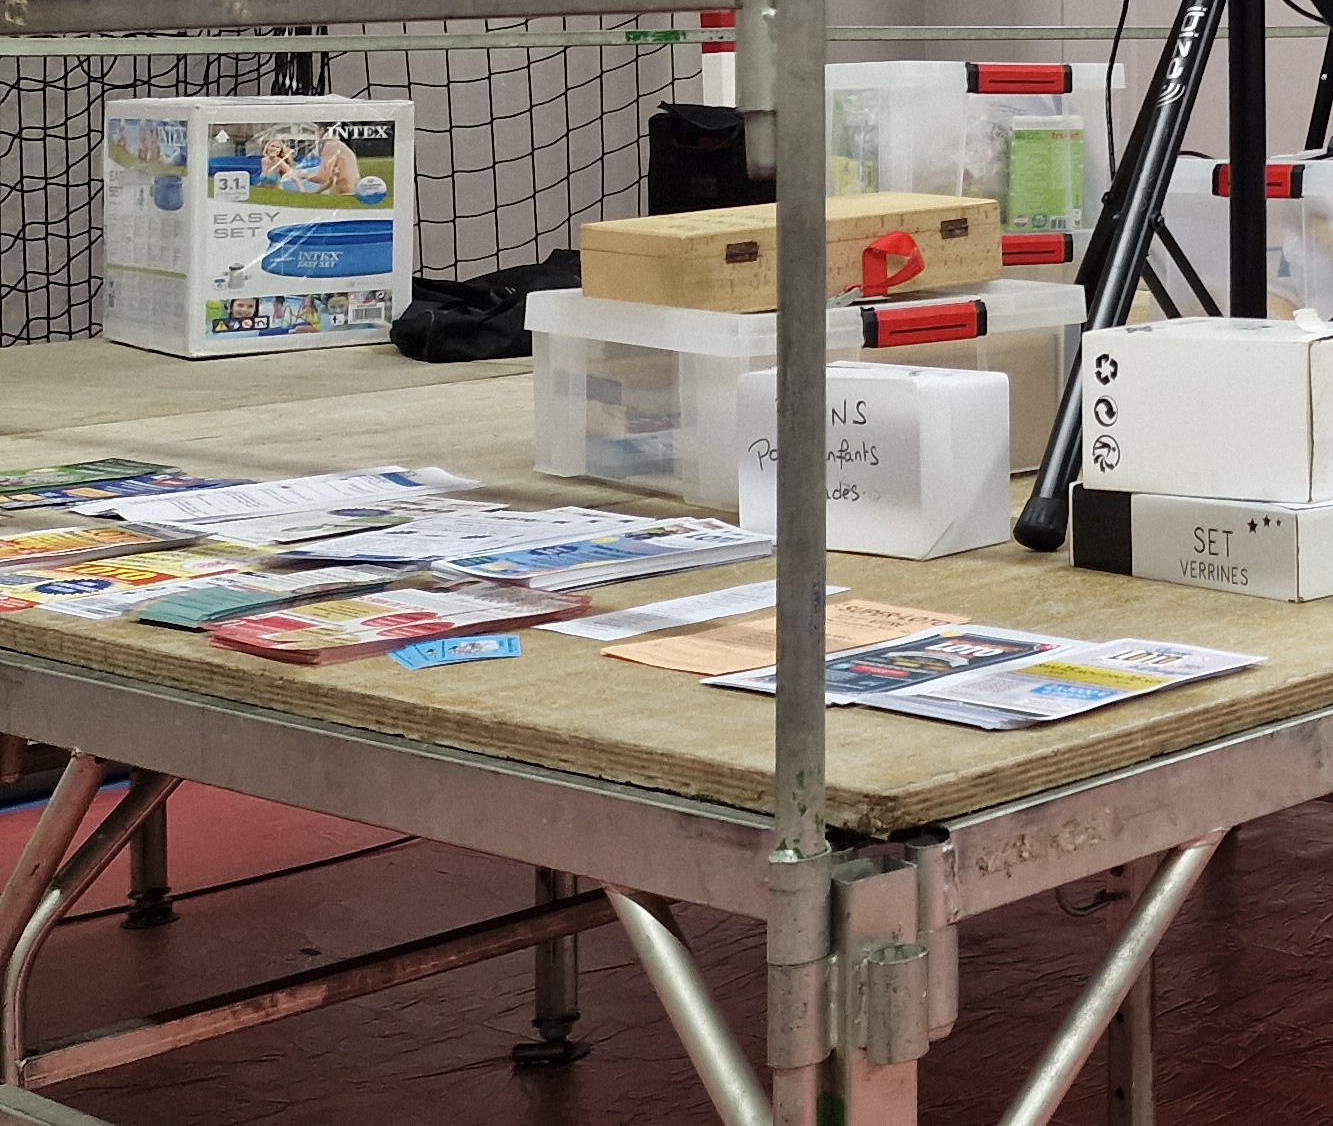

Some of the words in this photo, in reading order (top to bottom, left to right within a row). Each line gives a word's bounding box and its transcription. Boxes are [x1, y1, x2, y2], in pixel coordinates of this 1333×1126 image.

[1166, 5, 1209, 80] ibiza
[327, 125, 390, 140] INTEX
[218, 177, 240, 191] 3.1
[213, 211, 281, 225] EASY
[213, 226, 262, 239] SET
[298, 250, 344, 262] INTEX
[297, 260, 317, 269] EASY
[318, 259, 337, 269] SET
[748, 438, 779, 471] Po
[826, 438, 880, 470] nfants
[1192, 526, 1234, 559] SET
[1179, 558, 1249, 586] VERRINES
